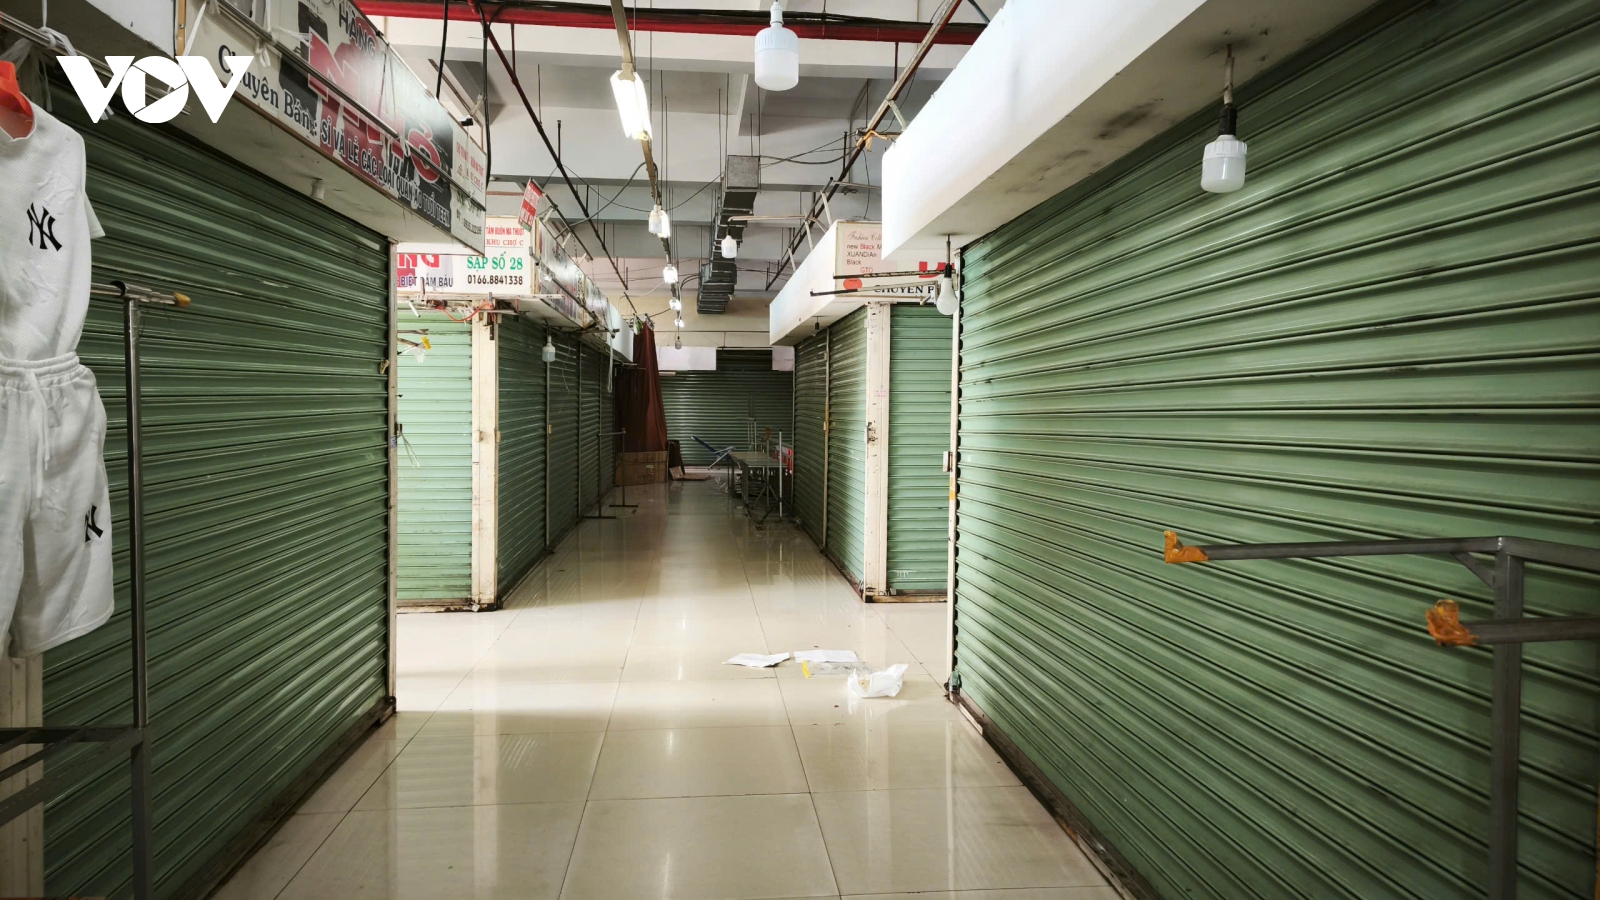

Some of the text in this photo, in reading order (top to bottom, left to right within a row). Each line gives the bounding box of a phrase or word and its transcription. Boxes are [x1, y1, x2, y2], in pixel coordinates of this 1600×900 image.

[339, 2, 376, 58] HÀNG
[218, 44, 279, 109] Cuyên
[333, 126, 345, 157] VÀ
[361, 147, 377, 176] CÁC
[26, 202, 63, 252] NY
[467, 251, 523, 272] SẠP SỐ 28
[846, 258, 862, 266] Black
[401, 273, 417, 288] BIỆT
[467, 274, 523, 286] 0166.8841338
